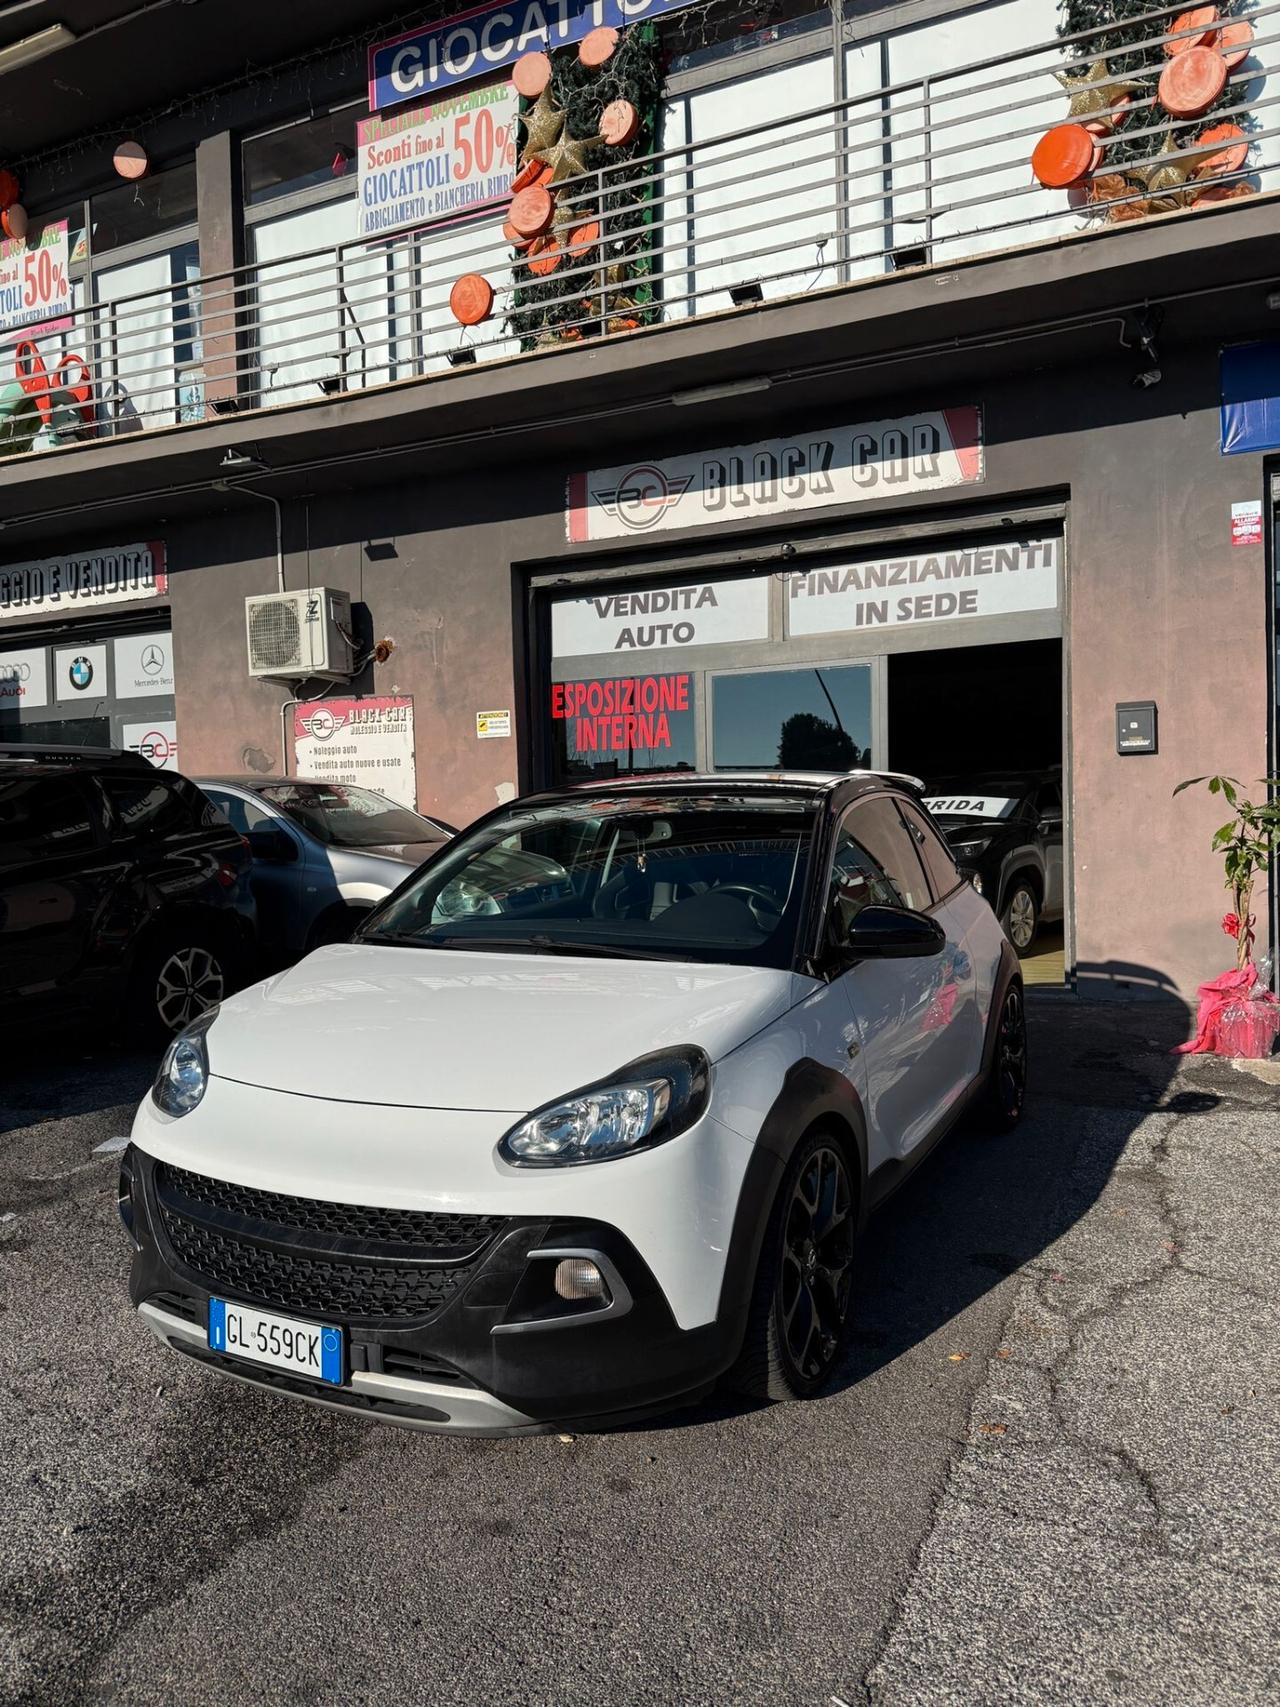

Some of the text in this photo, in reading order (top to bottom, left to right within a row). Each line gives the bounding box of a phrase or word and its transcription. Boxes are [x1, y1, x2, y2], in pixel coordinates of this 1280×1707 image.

[368, 108, 515, 181] Sconti fino al 50%
[364, 154, 450, 207] GIOCATTOLI
[365, 197, 425, 233] ABBIGLIAMENTO
[435, 182, 485, 213] BIANCHERIA
[25, 250, 67, 307] 50%
[703, 440, 834, 512] BLACK
[851, 424, 940, 487] CAR
[49, 565, 61, 602] E
[66, 551, 156, 599] VENDITA
[593, 543, 1053, 619] VENDITA FINANZIAMENTI
[855, 589, 979, 626] IN SEDE
[614, 621, 696, 650] AUTO
[349, 708, 381, 724] BLACK
[385, 706, 408, 724] CAR
[552, 674, 689, 719] ESPOSIZIONE
[313, 745, 357, 757] Noleggio auto
[575, 712, 672, 752] INTERNA
[314, 760, 338, 770] Vendita
[339, 759, 354, 769] auto
[356, 758, 375, 768] nuove
[382, 757, 401, 768] usate
